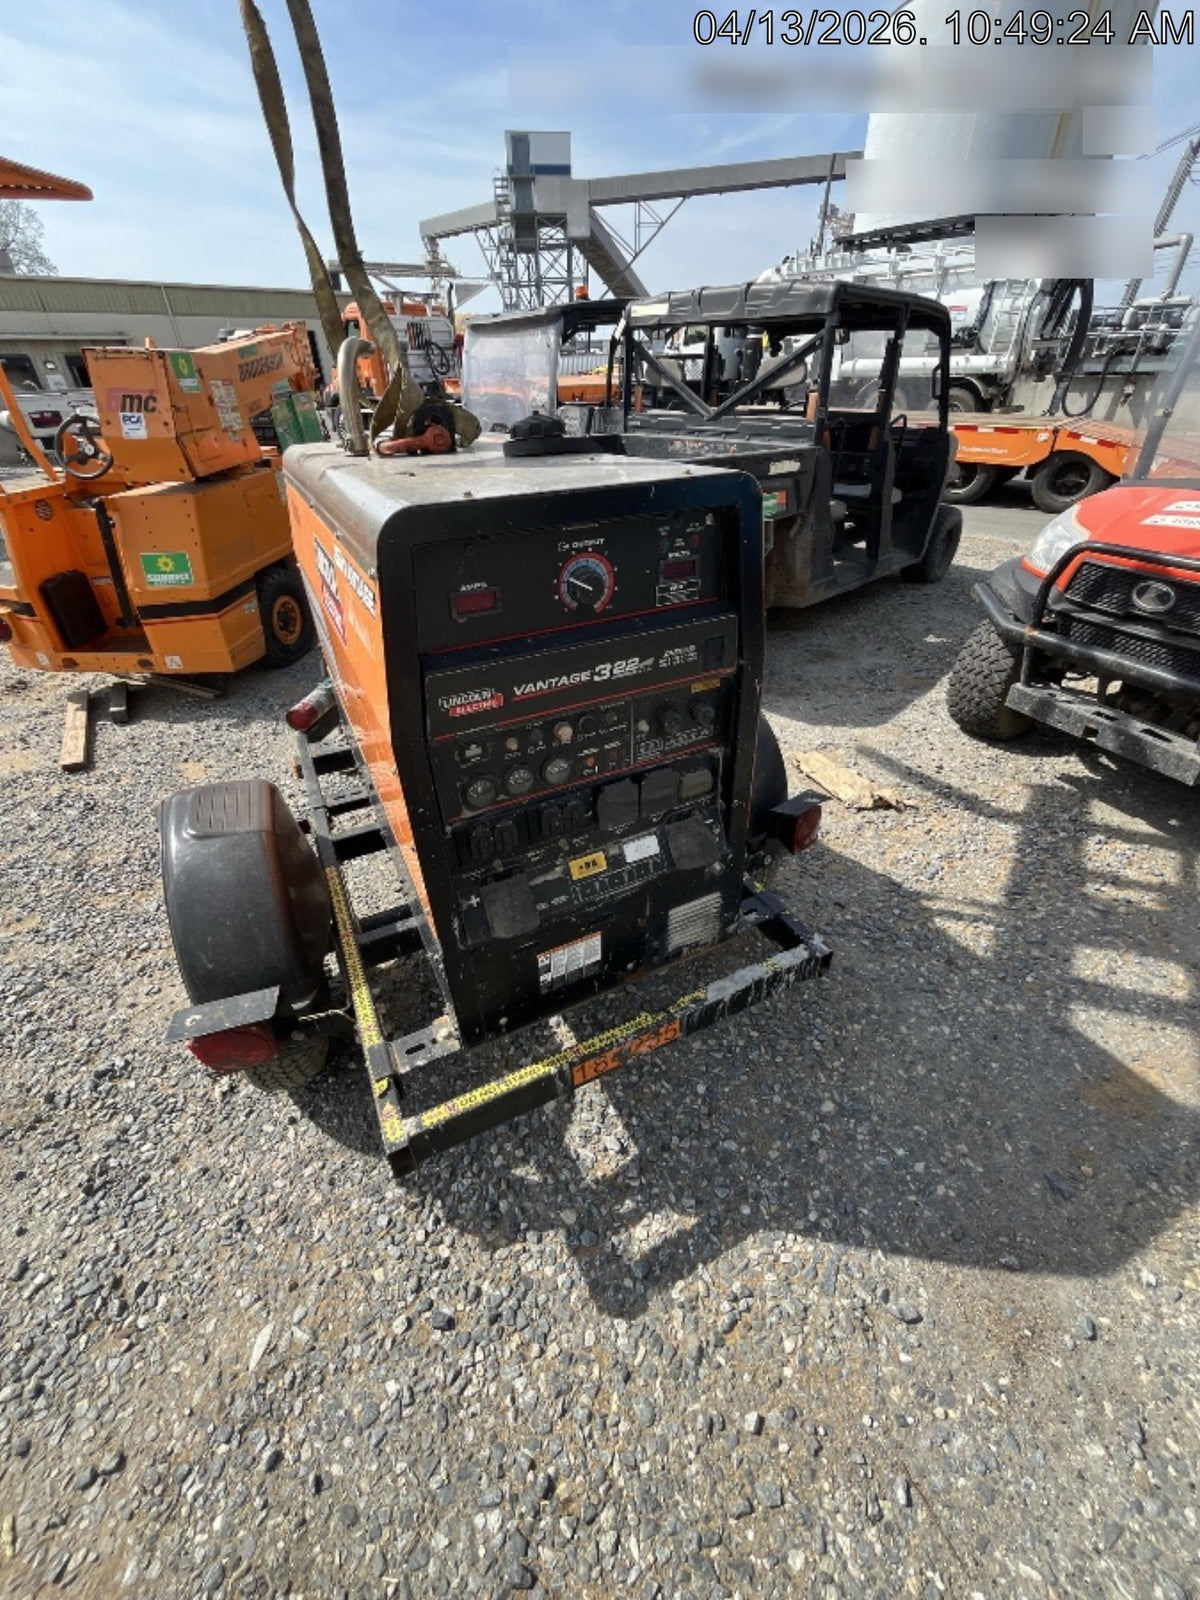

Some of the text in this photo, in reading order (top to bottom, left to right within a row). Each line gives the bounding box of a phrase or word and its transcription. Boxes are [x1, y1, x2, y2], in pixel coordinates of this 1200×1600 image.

[460, 581, 488, 593] AMPS
[513, 669, 592, 696] VANTAGE
[594, 657, 640, 682] 322
[442, 689, 493, 710] LINCOLN
